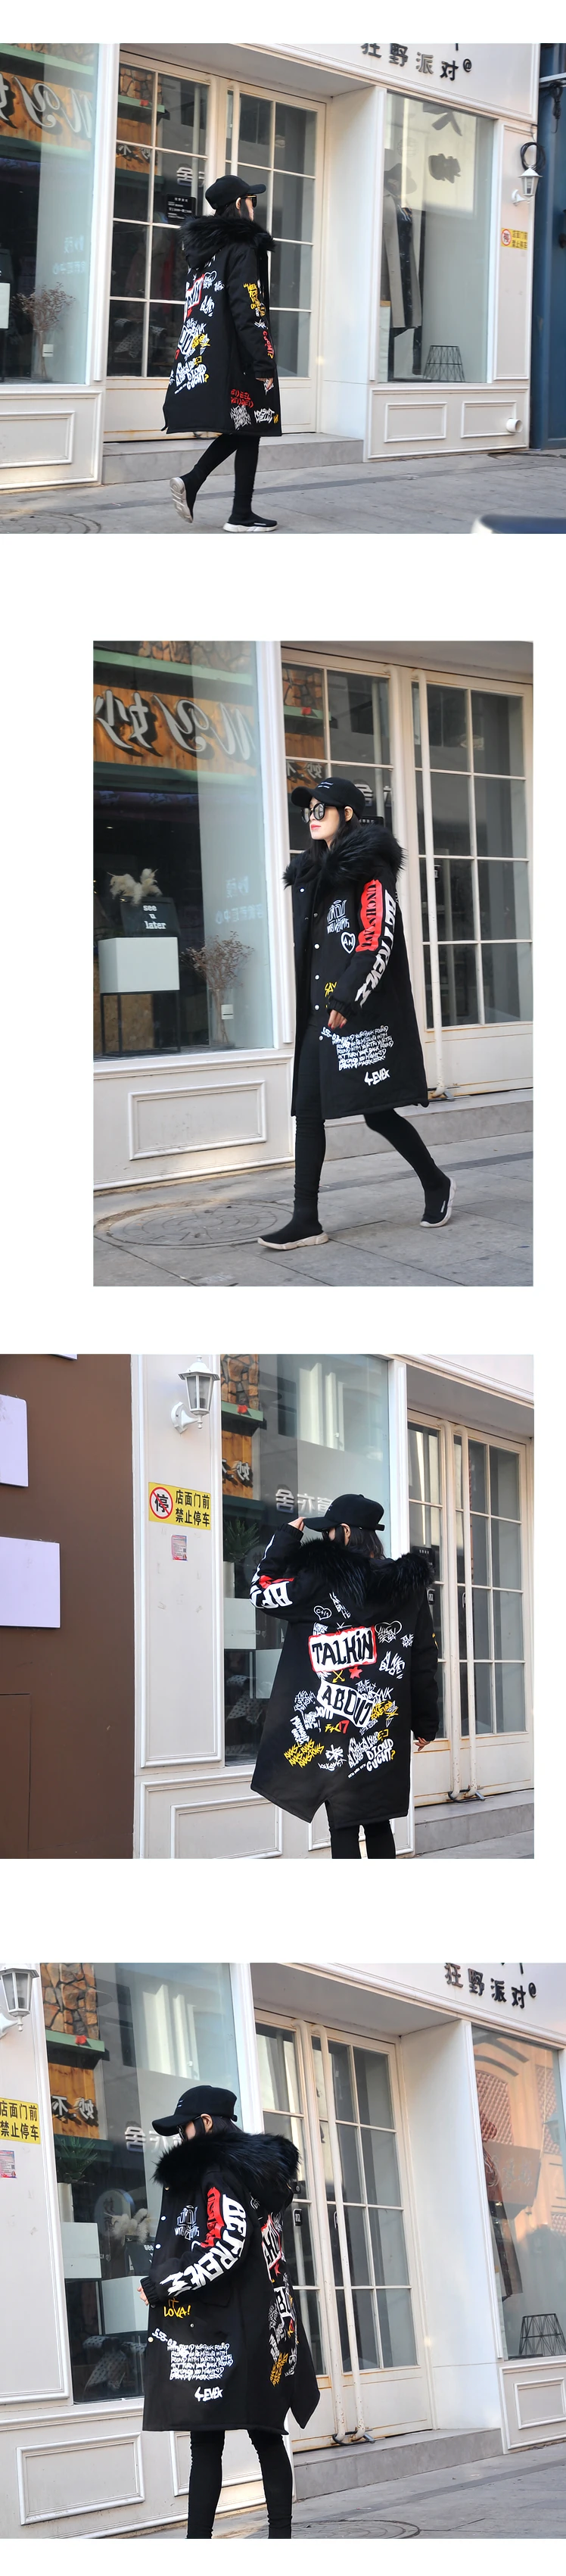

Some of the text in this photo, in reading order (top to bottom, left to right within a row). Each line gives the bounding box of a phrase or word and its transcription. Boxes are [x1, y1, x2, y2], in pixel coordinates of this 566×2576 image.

[144, 921, 166, 929] later
[176, 1489, 210, 1510] 店面门前
[176, 1508, 210, 1527] 禁止停车
[0, 2100, 37, 2122] 店面门前
[0, 2120, 39, 2141] 禁止停车
